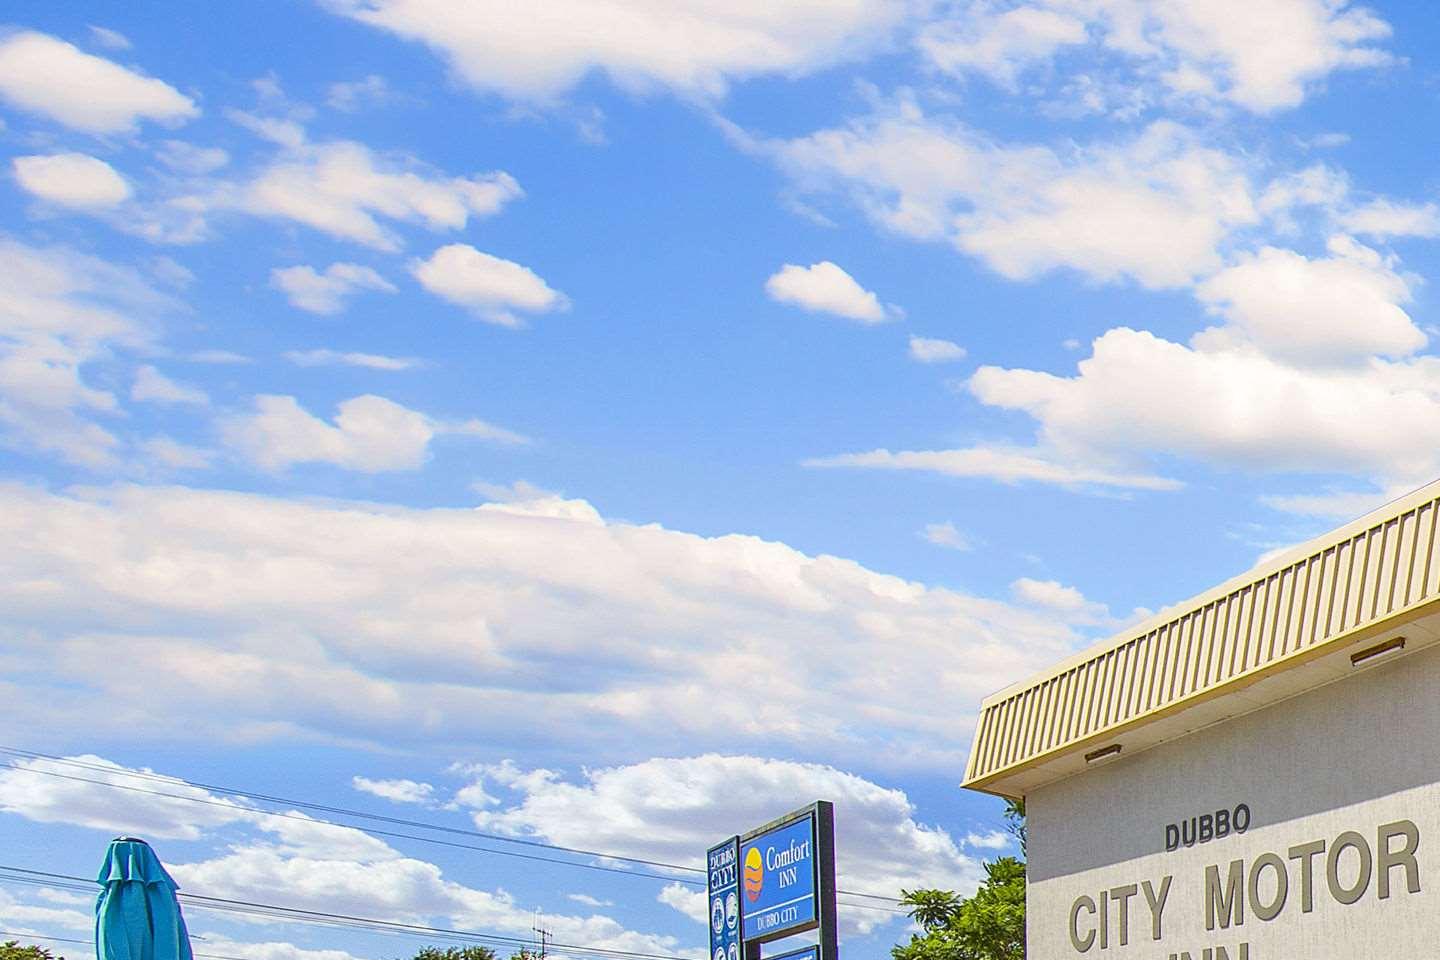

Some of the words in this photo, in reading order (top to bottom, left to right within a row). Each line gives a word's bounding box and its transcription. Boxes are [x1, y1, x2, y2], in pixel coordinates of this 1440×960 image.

[1165, 803, 1251, 852] DUBBO
[766, 839, 810, 871] Comfort
[711, 864, 736, 889] CITY
[779, 867, 797, 888] INN
[1069, 875, 1173, 953] CITY
[1205, 819, 1421, 931] MOTOR
[757, 911, 780, 930] DUBBO
[781, 905, 798, 924] CITY
